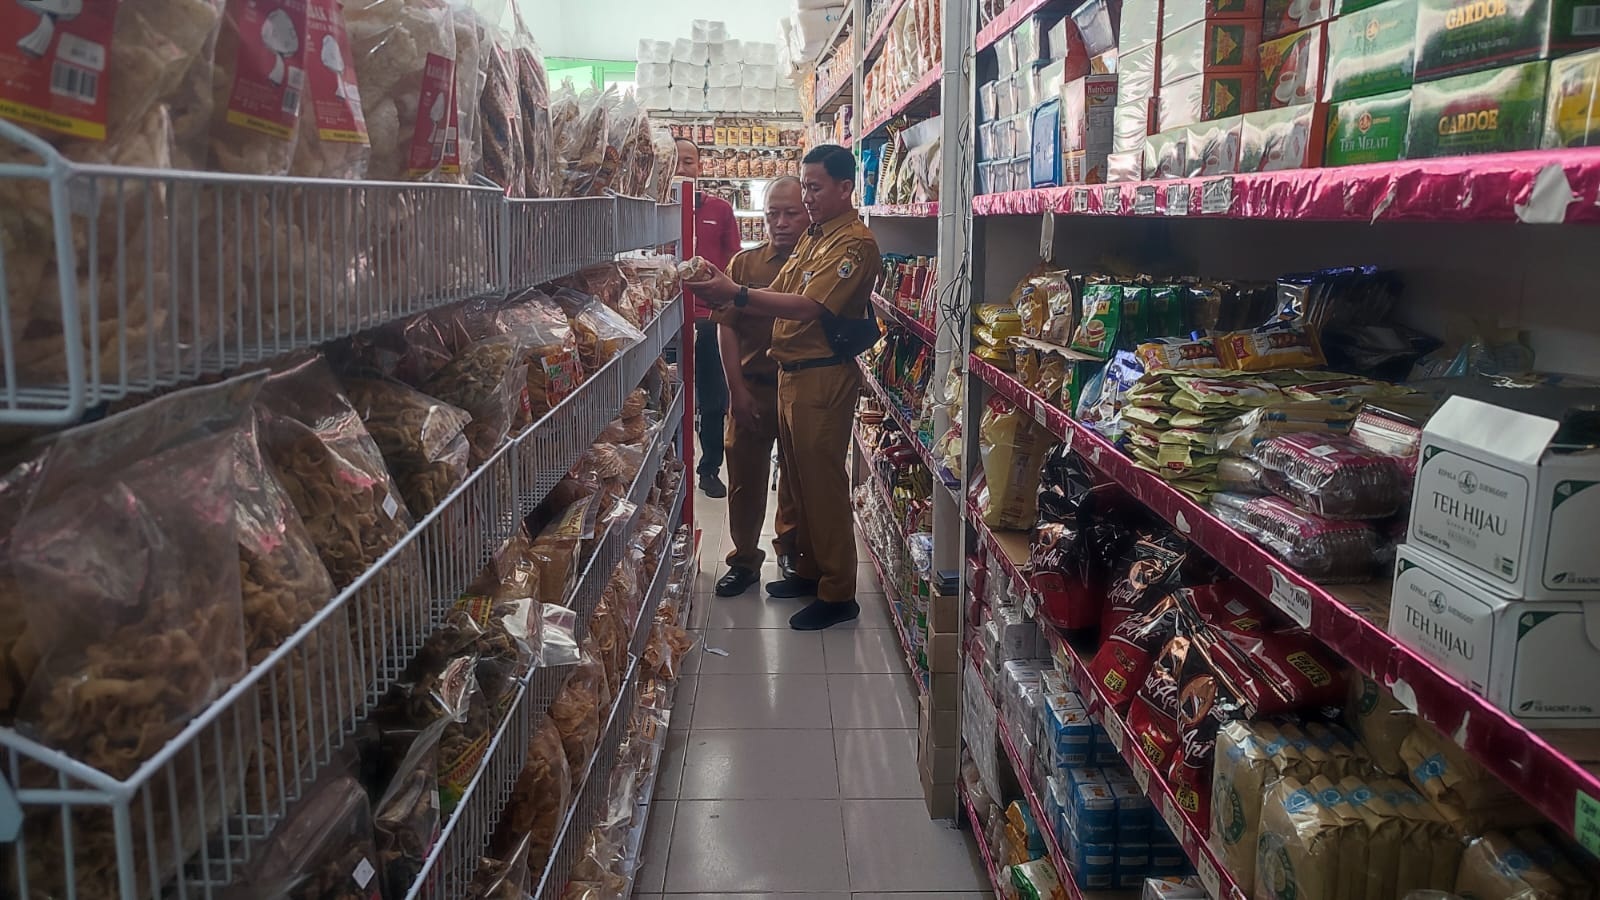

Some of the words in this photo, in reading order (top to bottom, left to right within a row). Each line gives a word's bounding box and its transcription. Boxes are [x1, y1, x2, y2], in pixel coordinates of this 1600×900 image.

[1446, 0, 1507, 30] GARDOE
[1438, 109, 1499, 135] GARDOE
[1433, 491, 1460, 517] TEH
[1463, 505, 1508, 537] HIJAU
[1405, 604, 1430, 634] TEH
[1434, 622, 1475, 660] HIJAU
